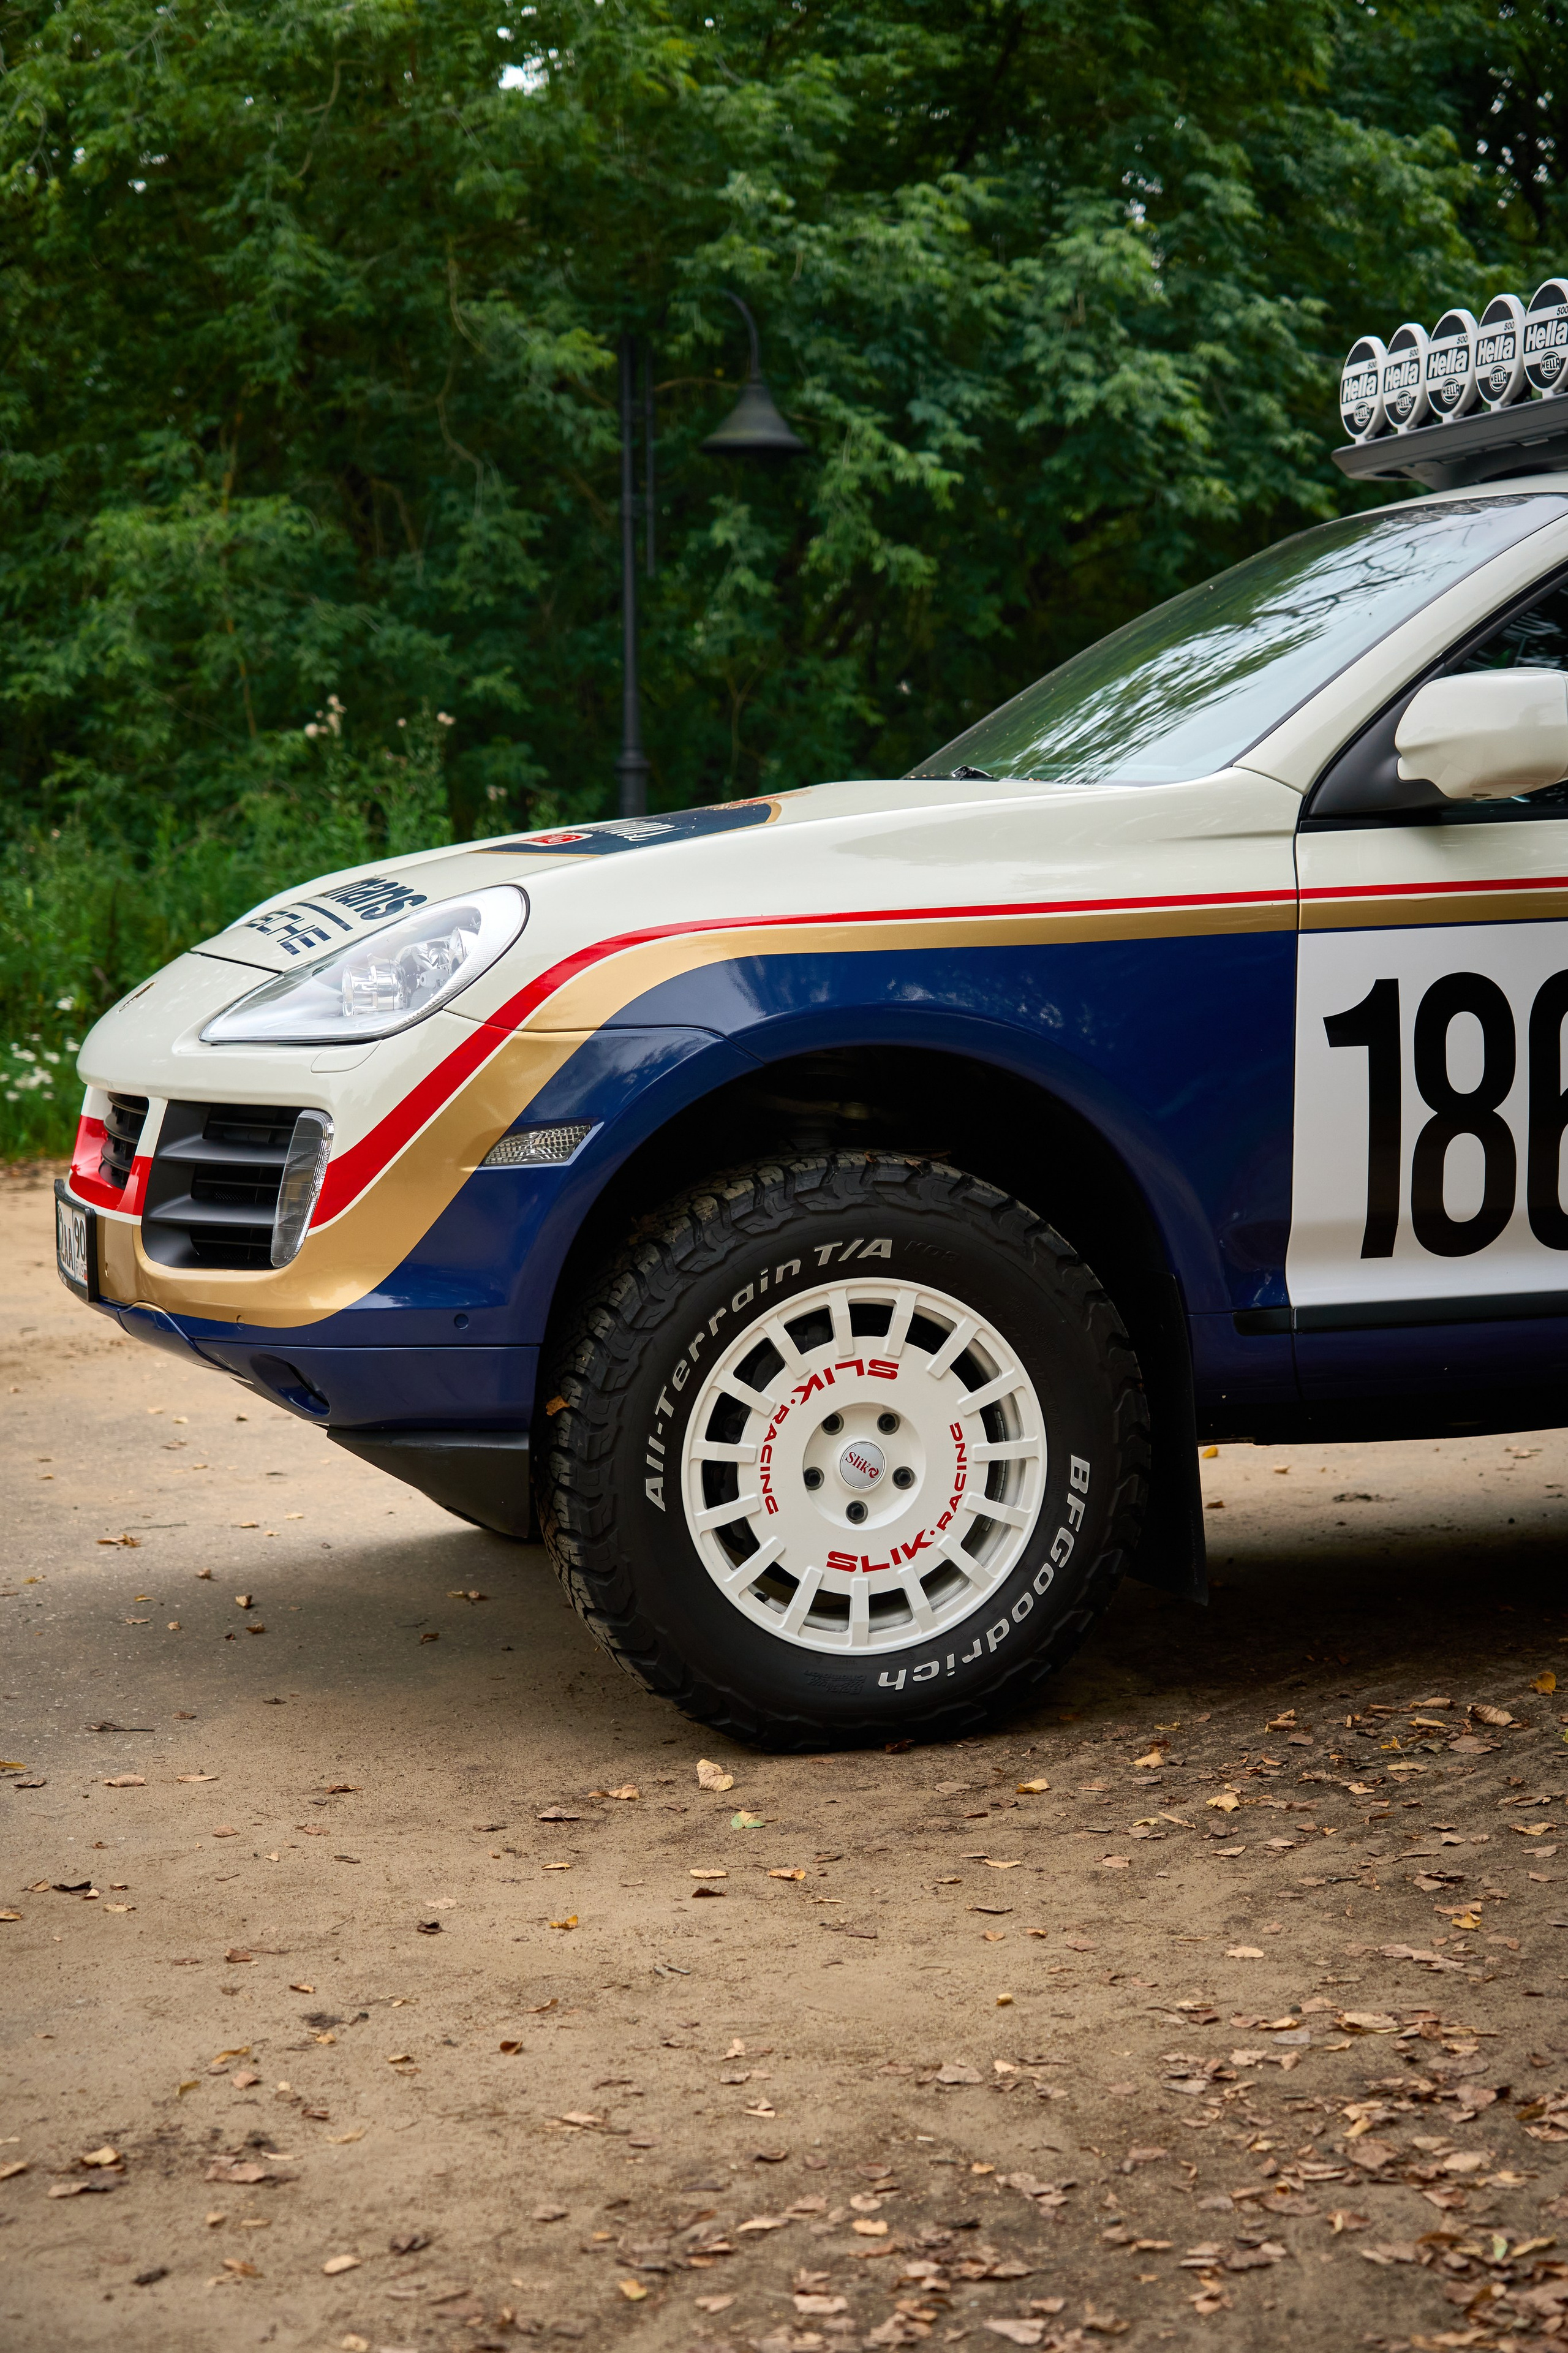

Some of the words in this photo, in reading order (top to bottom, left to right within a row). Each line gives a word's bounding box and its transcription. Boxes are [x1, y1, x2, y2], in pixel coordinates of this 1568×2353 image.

[1504, 321, 1515, 330] 500
[1557, 306, 1568, 315] 500
[1457, 335, 1468, 344] 500
[1477, 334, 1514, 366] Hella
[1525, 320, 1568, 352] Hella
[1384, 361, 1419, 391] Hella
[1428, 348, 1468, 379] Hella
[1490, 370, 1507, 383] HELLA
[1542, 357, 1560, 370] HELLA
[1343, 373, 1377, 403] Hella
[74, 1216, 86, 1262] 90
[645, 1259, 801, 1512] All-Terrain
[813, 1239, 892, 1266] T/A
[845, 1451, 869, 1474] Slik
[878, 1454, 1090, 1690] BFGoodrich
